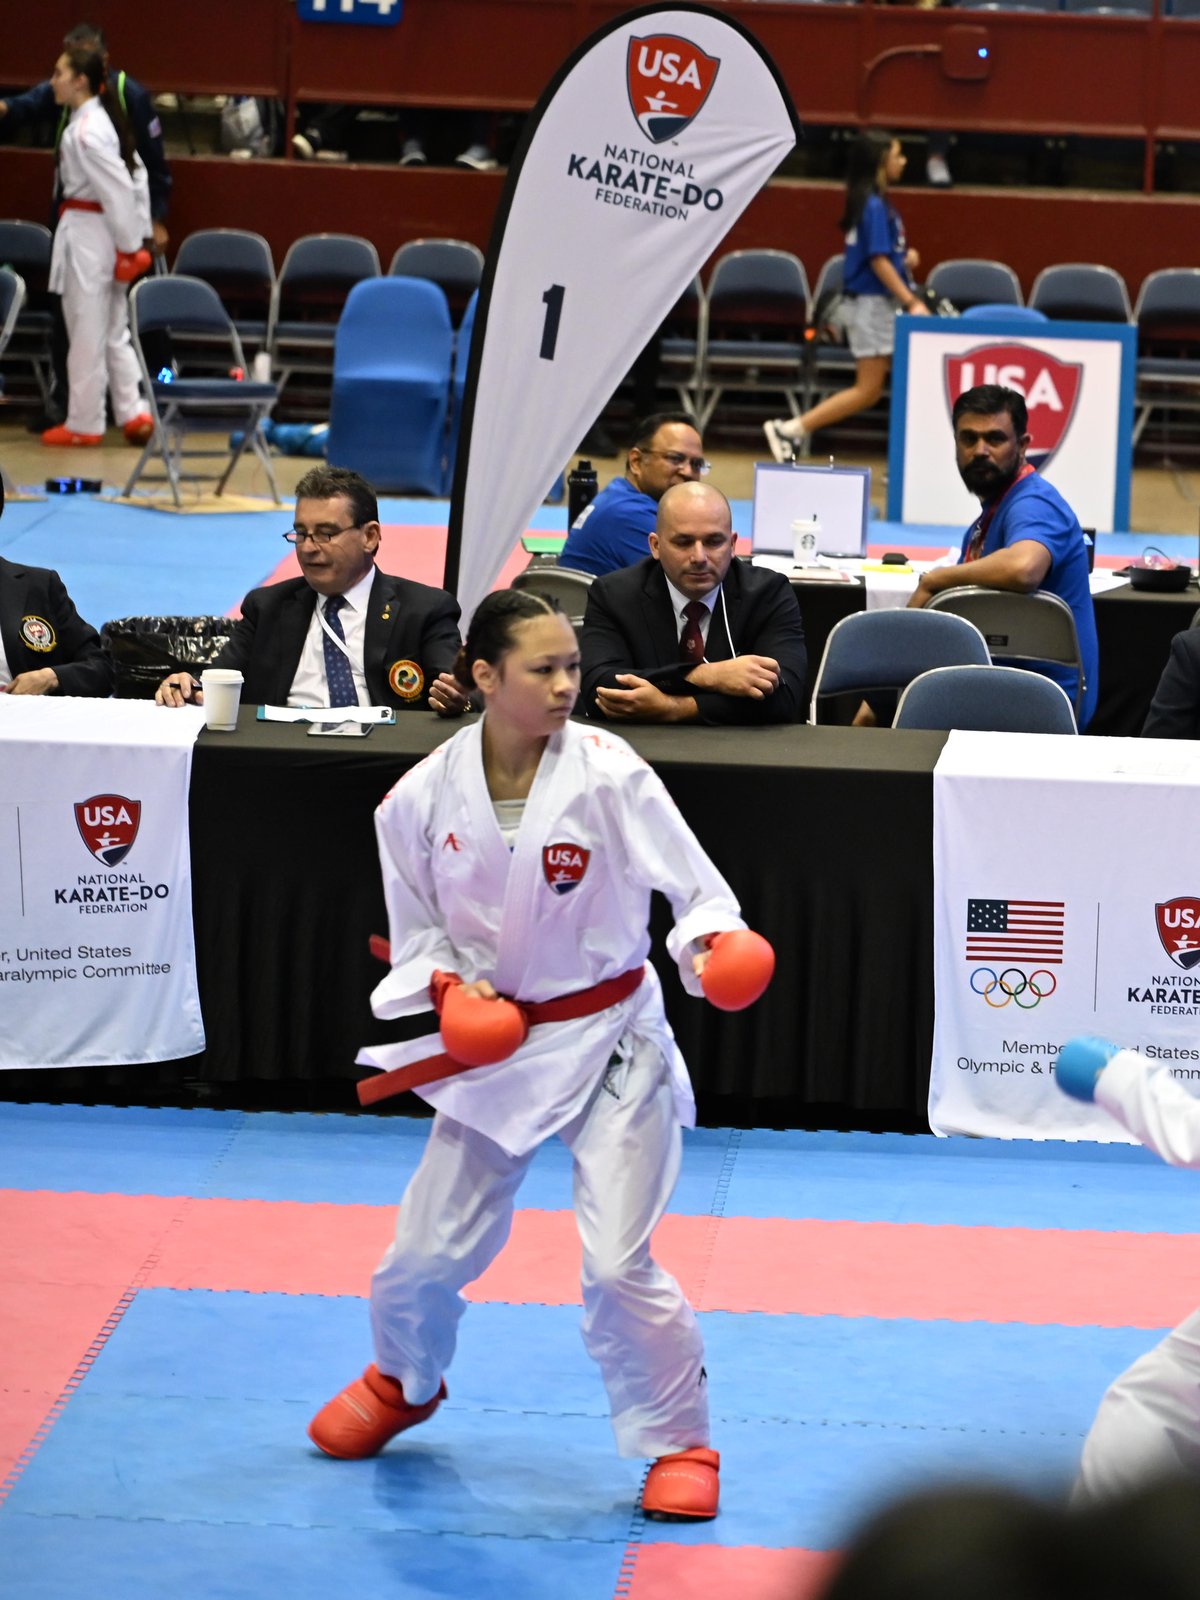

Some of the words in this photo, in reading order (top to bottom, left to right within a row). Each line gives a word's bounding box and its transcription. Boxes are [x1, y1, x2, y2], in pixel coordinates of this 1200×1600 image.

[637, 46, 701, 90] USA
[604, 143, 695, 179] NATIONAL
[567, 154, 723, 211] KARATE-DO
[595, 188, 689, 221] FEDERATION
[539, 283, 566, 361] 1
[83, 806, 133, 827] USA
[548, 850, 583, 867] USA
[77, 873, 145, 885] NATIONAL
[54, 884, 169, 904] KARATE-DO
[79, 903, 148, 914] FEDERATION
[16, 947, 72, 961] United
[77, 945, 132, 959] States
[82, 962, 171, 979] Committee
[1002, 1040, 1066, 1055] Membe
[1146, 1045, 1200, 1060] States
[957, 1057, 1024, 1075] Olympic
[1031, 1061, 1043, 1074] &
